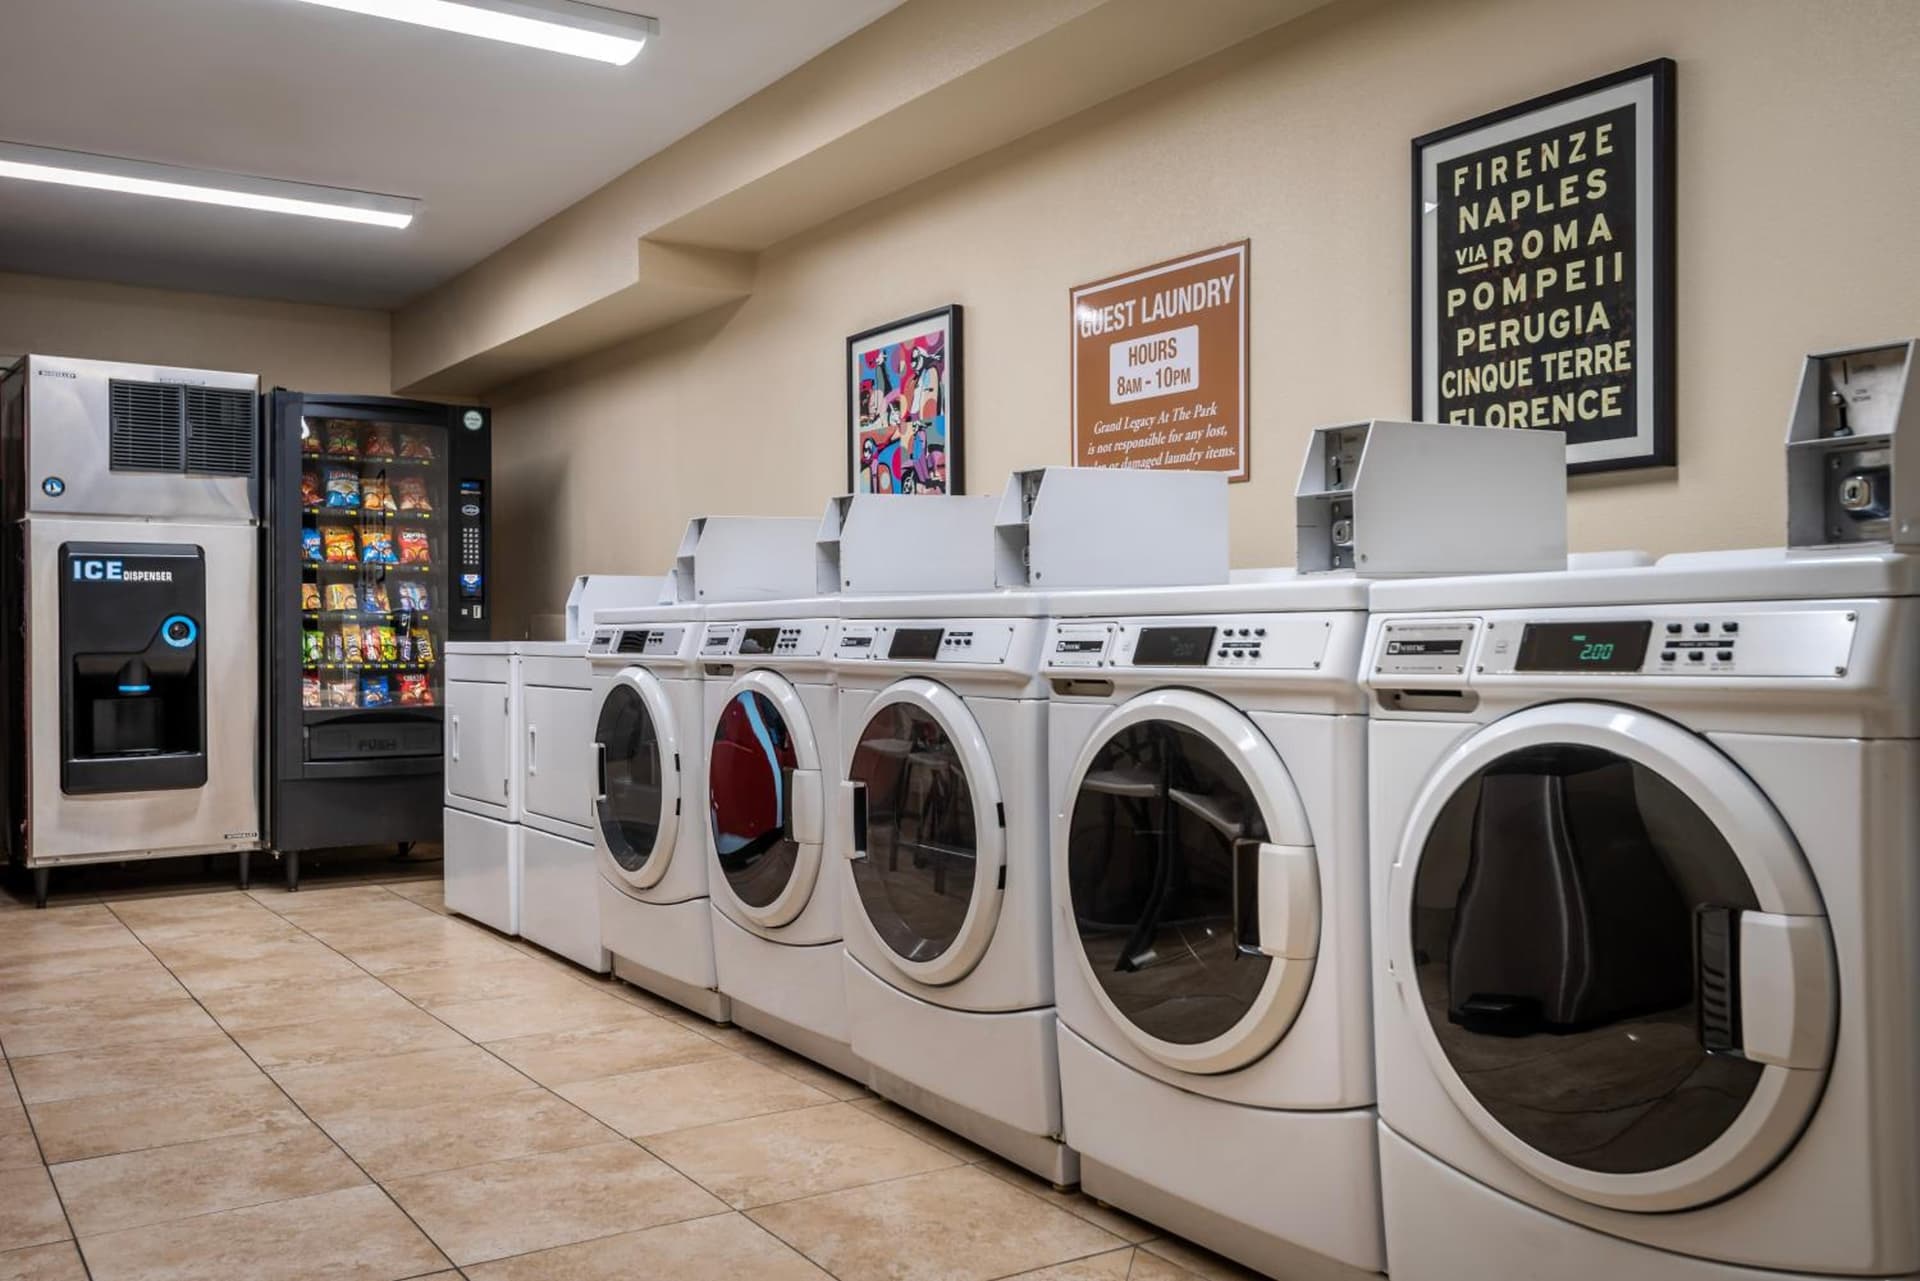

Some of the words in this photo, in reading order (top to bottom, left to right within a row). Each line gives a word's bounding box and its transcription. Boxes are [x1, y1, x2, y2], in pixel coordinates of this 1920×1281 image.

[1454, 123, 1614, 197] FIRENZE
[1458, 168, 1608, 234] NAPLES
[1455, 248, 1488, 271] VIA
[1493, 213, 1614, 268] ROMA
[1080, 299, 1137, 338] GUEST
[1141, 273, 1235, 324] LAUNDRY
[1447, 251, 1623, 318] POMPEII
[1128, 337, 1178, 367] HOURS
[1456, 300, 1611, 356] PERUGIA
[1116, 375, 1143, 397] 8AM
[1156, 366, 1191, 391] 10PM
[1441, 357, 1533, 399] CINQUE
[1541, 339, 1632, 383] TERRE
[1087, 443, 1096, 456] is
[1097, 442, 1112, 454] not
[1113, 432, 1166, 455] responsible
[1168, 428, 1184, 444] for
[1184, 428, 1204, 444] any
[1093, 419, 1122, 435] Grand
[1123, 414, 1155, 433] Legacy
[1157, 411, 1170, 425] At
[1172, 407, 1191, 422] The
[1194, 401, 1217, 418] Park
[1164, 447, 1204, 465] laundry
[73, 560, 123, 580] ICE
[123, 571, 173, 581] DISPENSER
